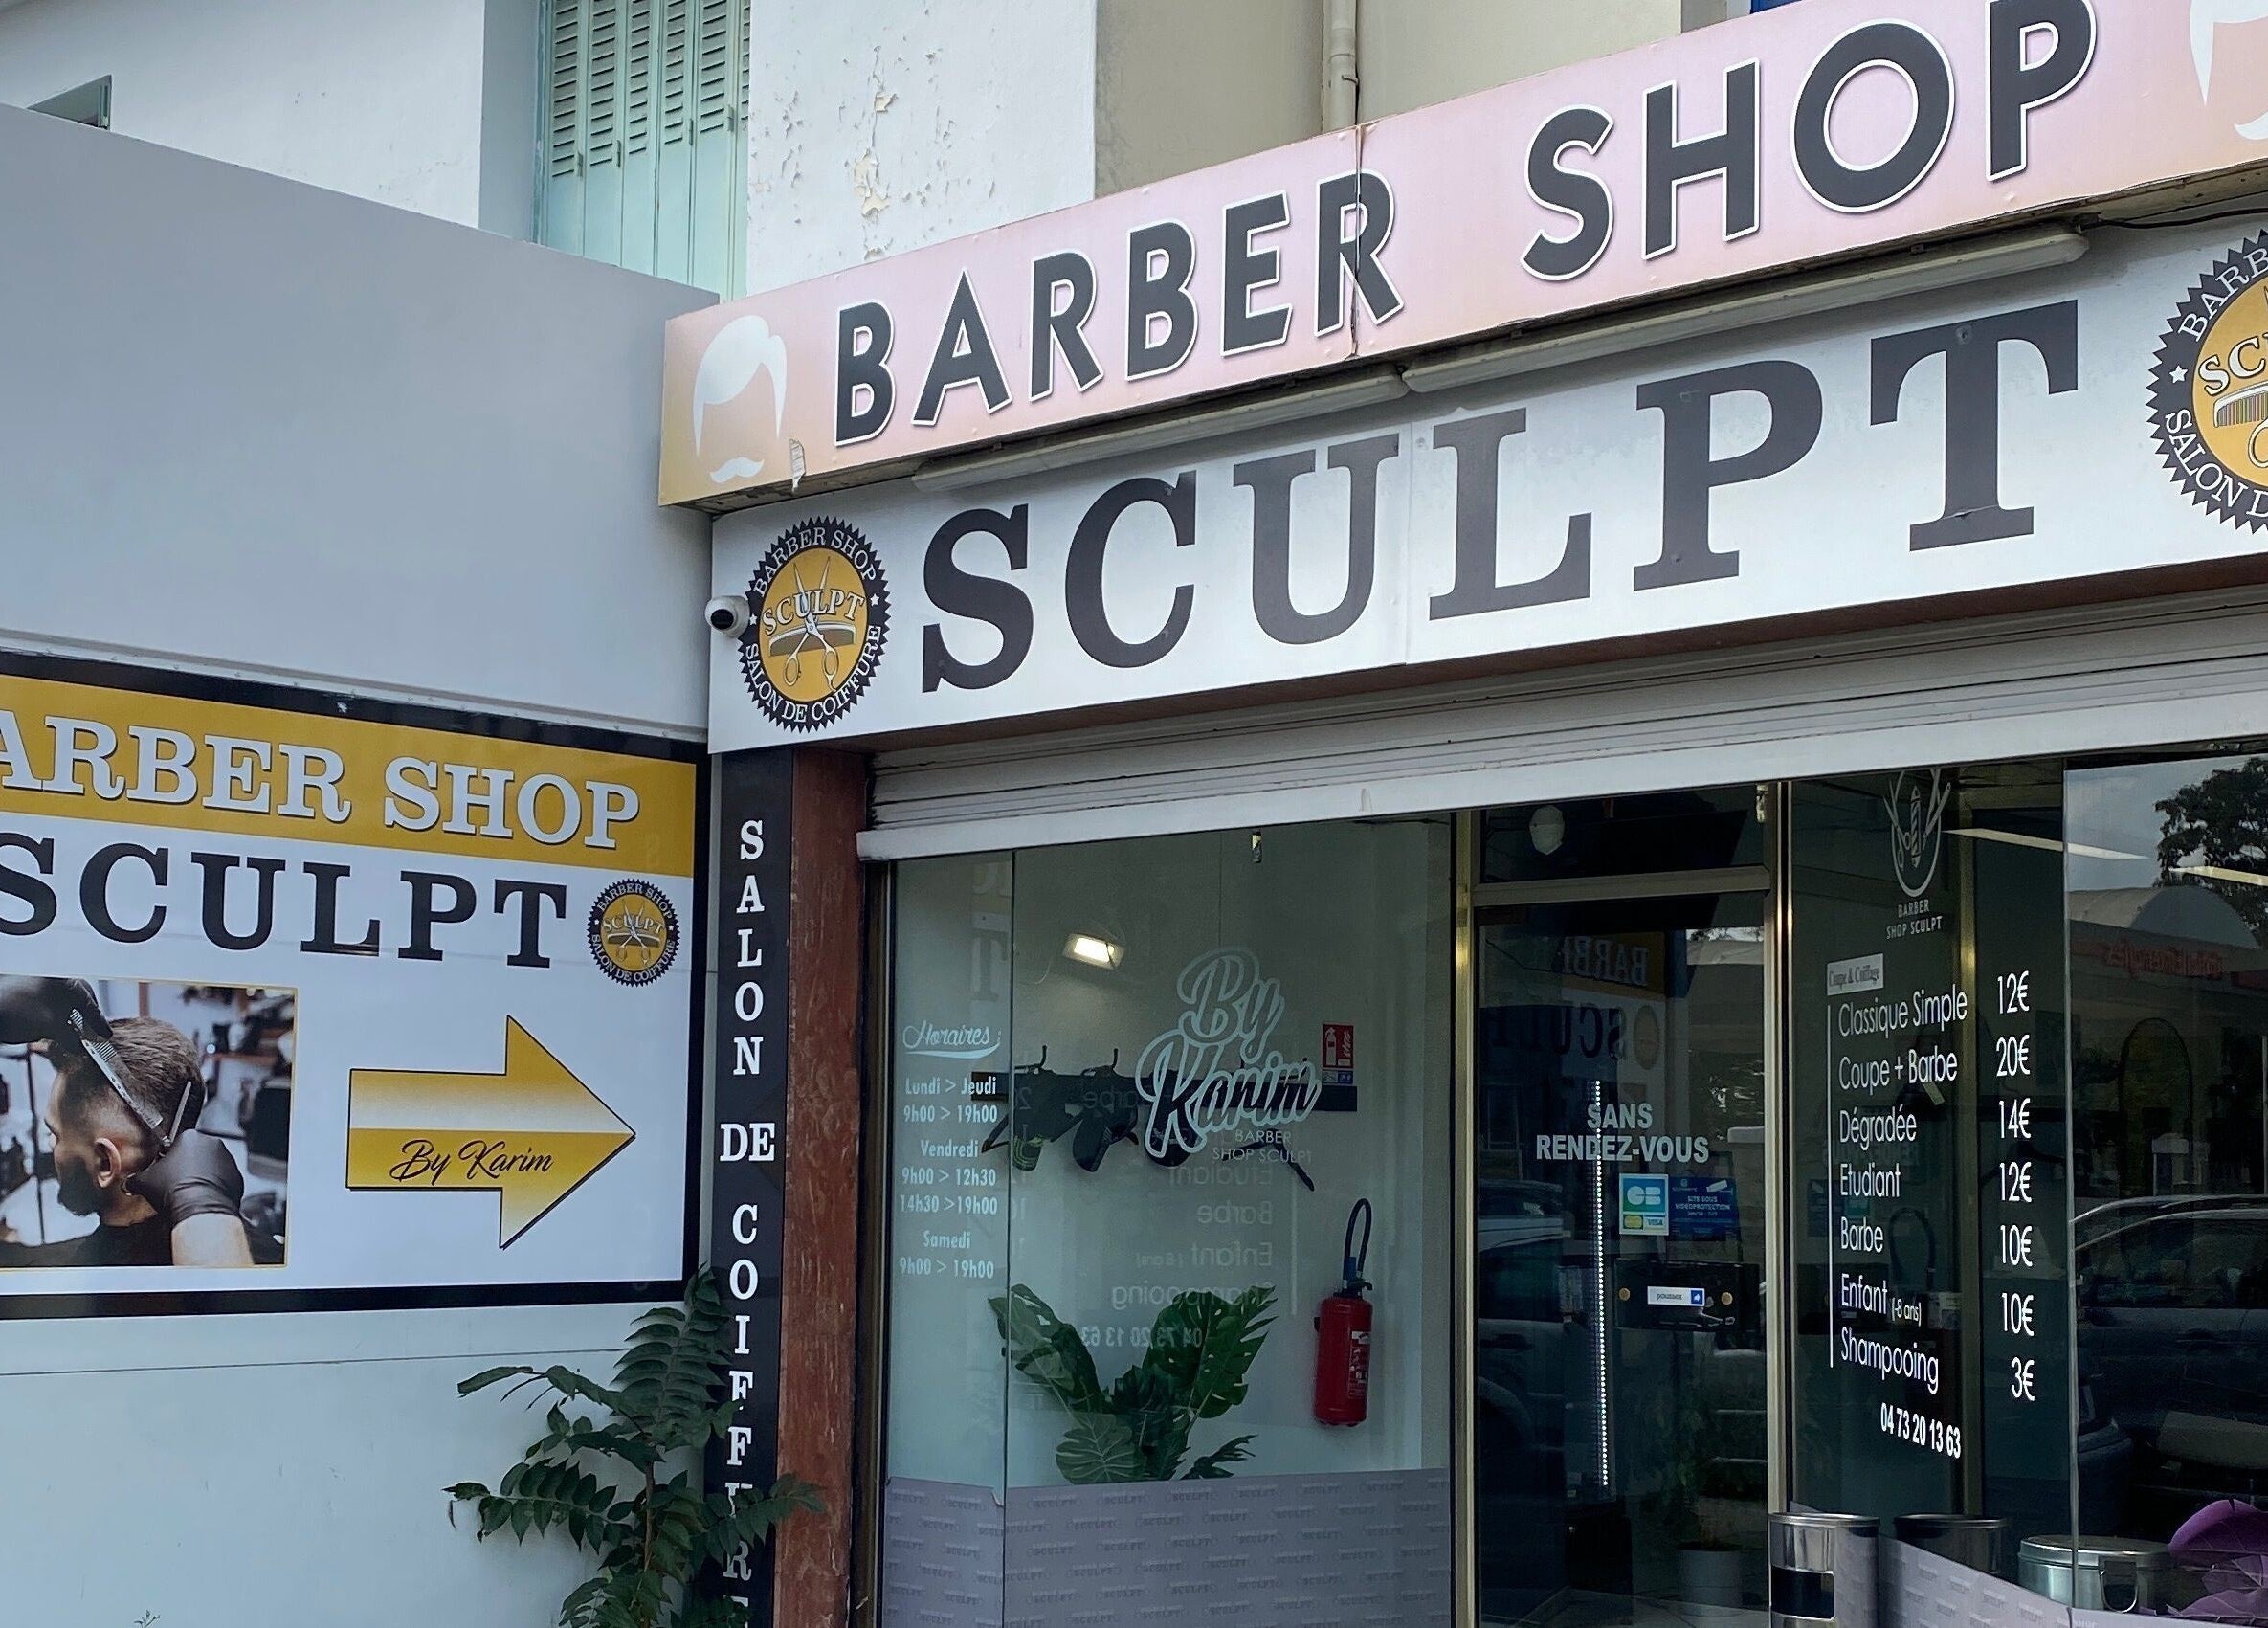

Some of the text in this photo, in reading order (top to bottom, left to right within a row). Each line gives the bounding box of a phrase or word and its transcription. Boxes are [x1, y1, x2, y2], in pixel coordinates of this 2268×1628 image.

[834, 0, 2097, 448] BARBER SHOP
[2199, 335, 2268, 397] SC
[2165, 408, 2248, 508] SALON
[922, 300, 2079, 694] SCULPT
[753, 526, 877, 598] BARBER SHOP
[762, 588, 865, 636] SCULPT
[745, 624, 881, 723] SALON DE COIFFURE
[384, 756, 640, 852] SHOP
[0, 831, 567, 969] SCULPT
[597, 882, 674, 920] BARBER SHOP
[1898, 898, 1930, 919] BARBER
[603, 914, 664, 935] SCULPT
[731, 820, 765, 1077] SALON
[1886, 915, 1944, 940] SHOP SCULPT
[591, 933, 615, 973] SALON
[615, 968, 633, 982] DE
[1838, 970, 2030, 1039] Classique Simple 12€
[902, 1019, 990, 1049] Horaires
[1135, 947, 1323, 1159] By Karim
[905, 1077, 941, 1095] Lundi
[960, 1076, 997, 1096] Jeudi
[1838, 1034, 2031, 1097] Coupe + Barbe 20€
[903, 1104, 935, 1123] 9h00
[957, 1104, 998, 1124] 19h00
[1234, 1128, 1292, 1144] BARBER
[1587, 1102, 1653, 1130] SANS
[1839, 1097, 2032, 1151] Dégradée 14€
[389, 1139, 554, 1187] By Karim
[721, 1123, 776, 1162] DE
[920, 1139, 979, 1158] Vendredi
[1212, 1147, 1313, 1165] SHOP SCULPT
[1536, 1134, 1709, 1164] RENDEZ-VOUS
[901, 1167, 934, 1185] 9h00
[956, 1168, 996, 1186] 12h30
[1840, 1161, 2033, 1203] Etudiant 12€
[901, 1194, 940, 1213] 14h30
[957, 1195, 998, 1215] 19h00
[923, 1230, 971, 1249] Samedi
[1840, 1215, 2034, 1268] Barbe 10€
[900, 1257, 932, 1276] 9h00
[954, 1260, 994, 1280] 19h00
[1840, 1272, 2035, 1337] Enfant (-8 ans) 10€
[1840, 1325, 2035, 1402] Shampooing 3€
[1880, 1401, 1962, 1460] 04 73 20 13 63
